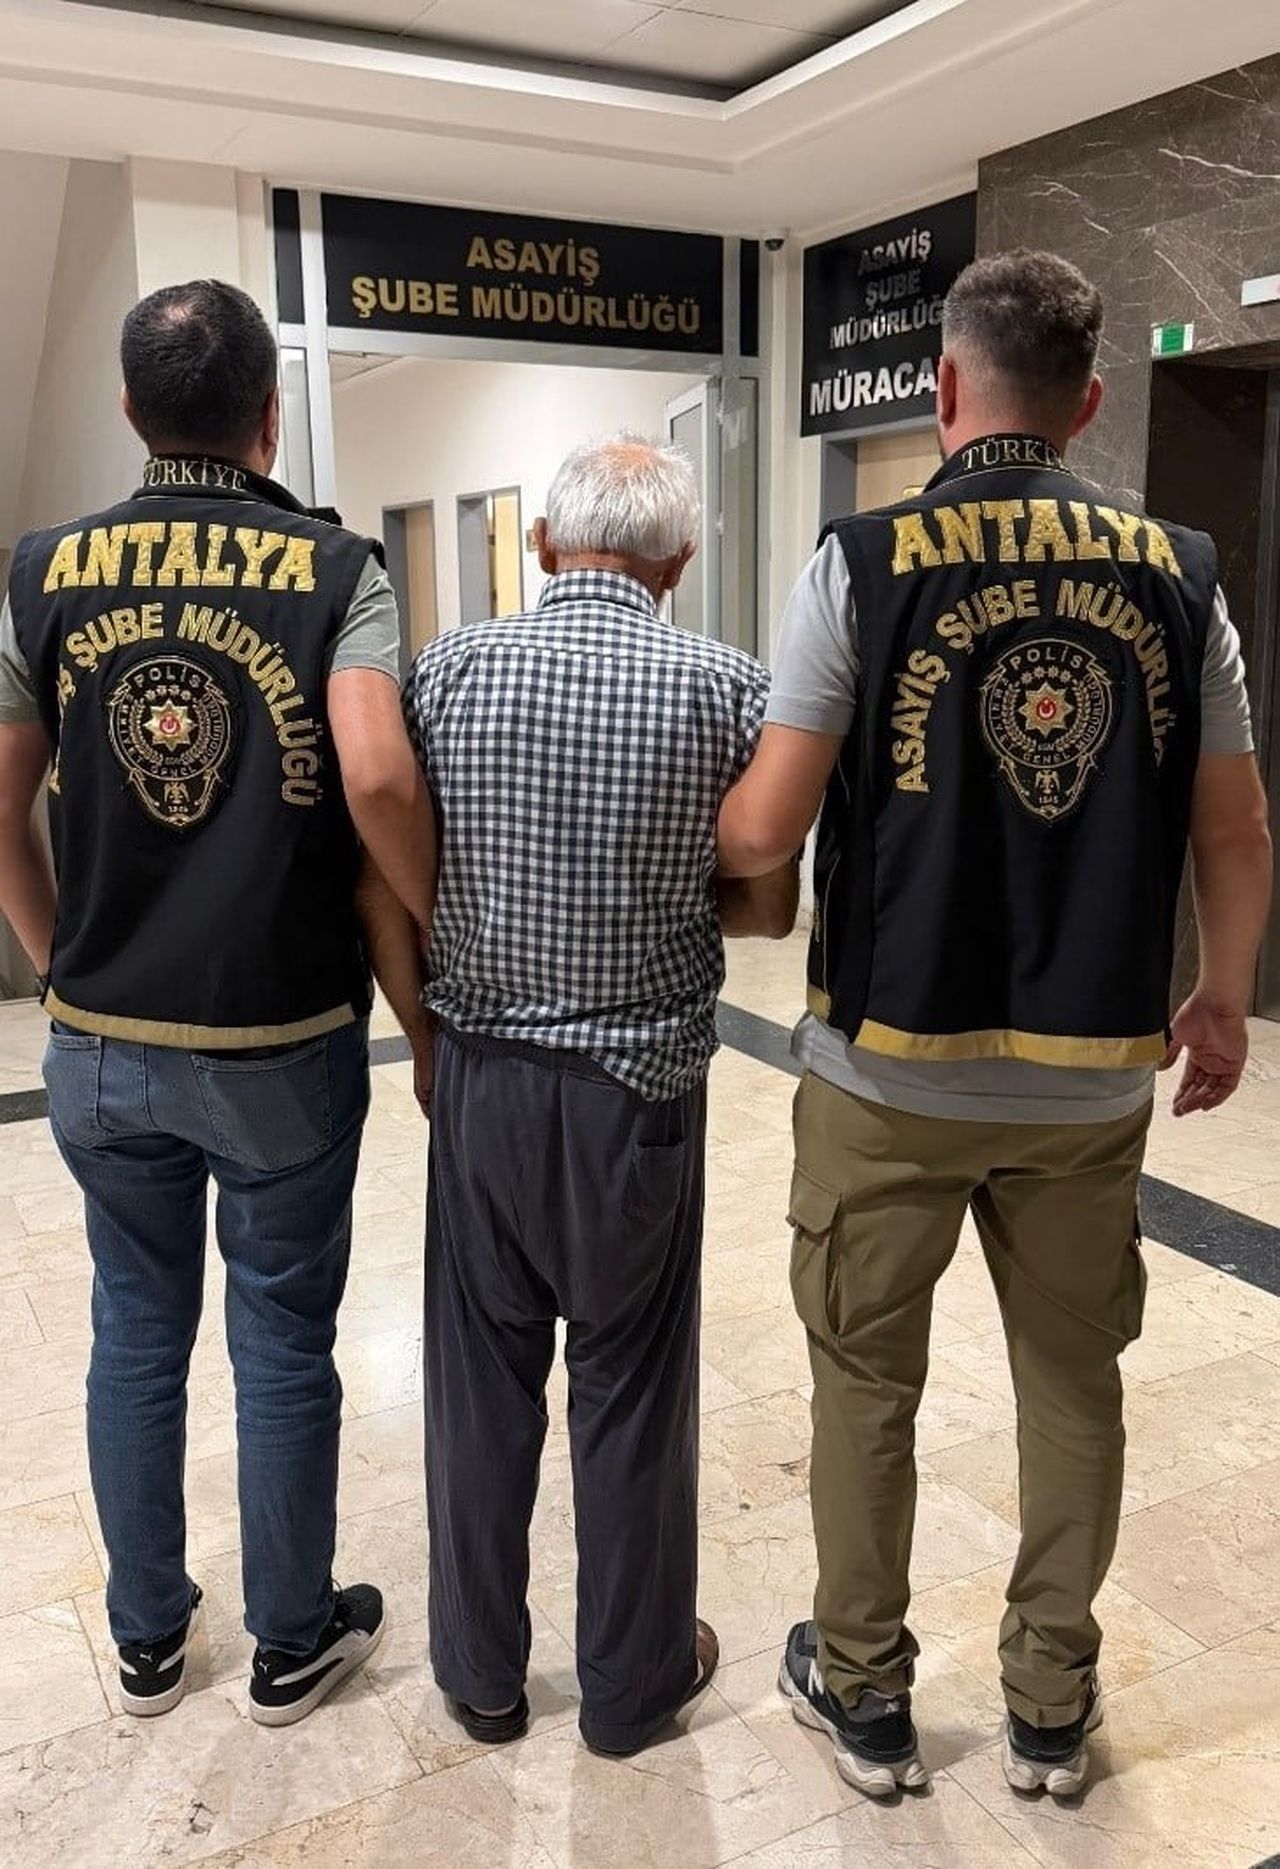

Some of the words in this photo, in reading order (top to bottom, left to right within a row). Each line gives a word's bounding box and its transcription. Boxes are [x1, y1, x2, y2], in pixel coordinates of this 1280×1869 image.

[466, 236, 600, 286] ASAYİŞ
[857, 228, 933, 276] ASAYİŞ
[352, 276, 459, 319] ŞUBE
[472, 284, 700, 334] MÜDÜRLÜĞÜ
[865, 268, 922, 311] ŞUBE
[830, 294, 943, 349] MÜDÜRLÜĞ
[810, 357, 938, 416] MÜRACA
[962, 437, 1061, 470] TÜRKİ
[43, 521, 317, 593] ANTALYA
[891, 499, 1183, 579] ANTALYA
[134, 666, 201, 688] POLİS
[1010, 645, 1083, 669] POLİS
[66, 602, 164, 673] ŞUBE
[177, 603, 325, 807] MÜDÜRLÜĞÜ
[891, 649, 952, 793] ASAYİŞ
[936, 579, 1040, 656] ŞUBE
[1055, 579, 1177, 768] MÜDÜRLÜ
